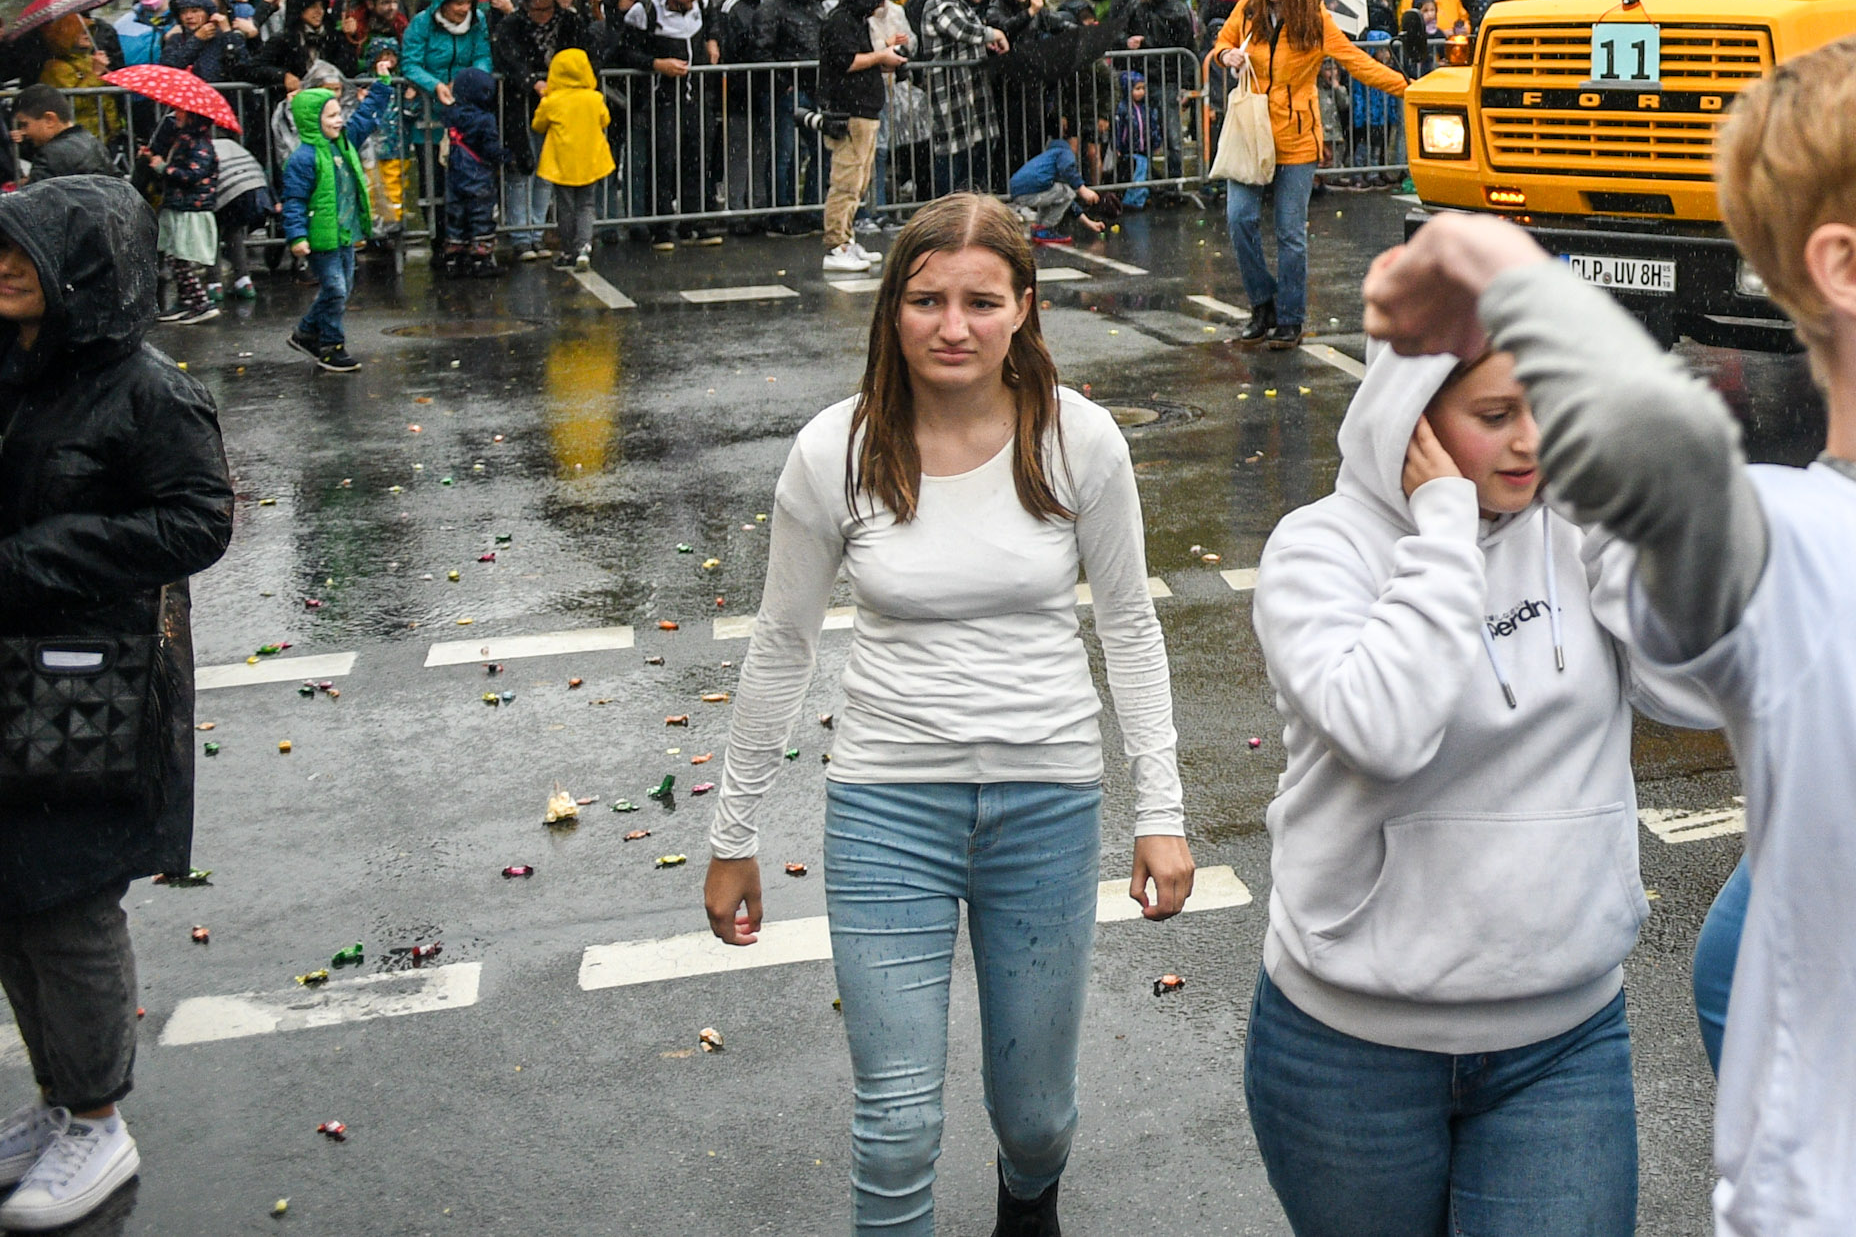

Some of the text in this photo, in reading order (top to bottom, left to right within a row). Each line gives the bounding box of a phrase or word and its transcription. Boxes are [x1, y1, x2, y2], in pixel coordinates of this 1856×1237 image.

[1599, 39, 1651, 80] 11
[1522, 91, 1723, 110] FORD
[1615, 261, 1636, 285] UV
[1640, 263, 1662, 287] 8H
